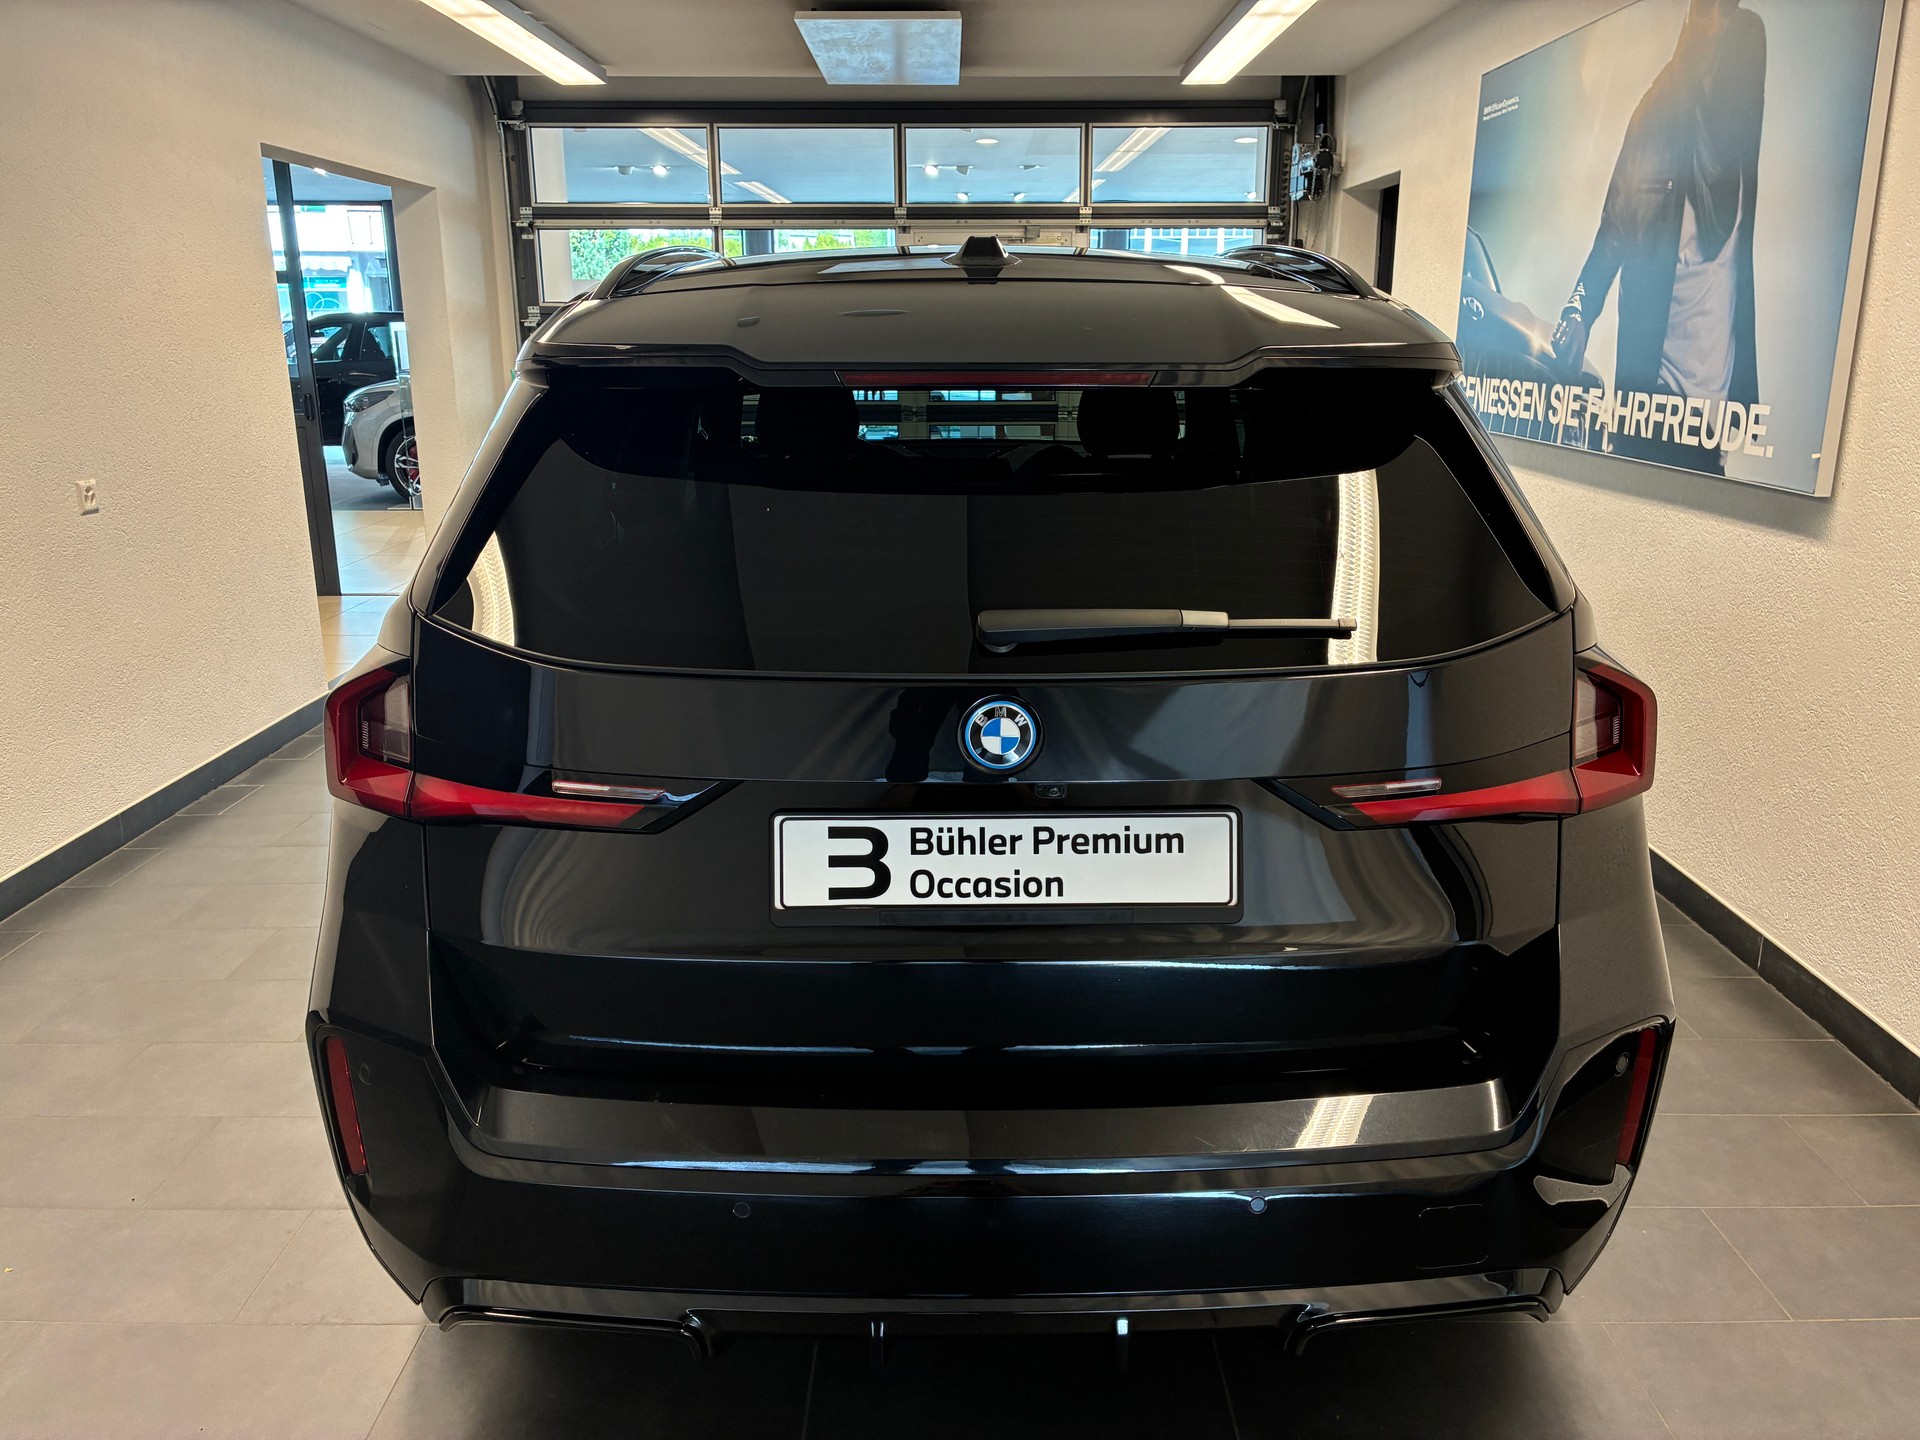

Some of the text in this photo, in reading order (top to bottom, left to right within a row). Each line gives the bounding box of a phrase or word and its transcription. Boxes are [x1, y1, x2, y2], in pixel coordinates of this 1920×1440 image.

[1548, 383, 1583, 428] SIE
[1585, 387, 1773, 458] FAHRFREUDE.
[974, 706, 1027, 727] BMW
[911, 826, 1183, 855] Bühler Premium
[910, 870, 1063, 898] Occasion
